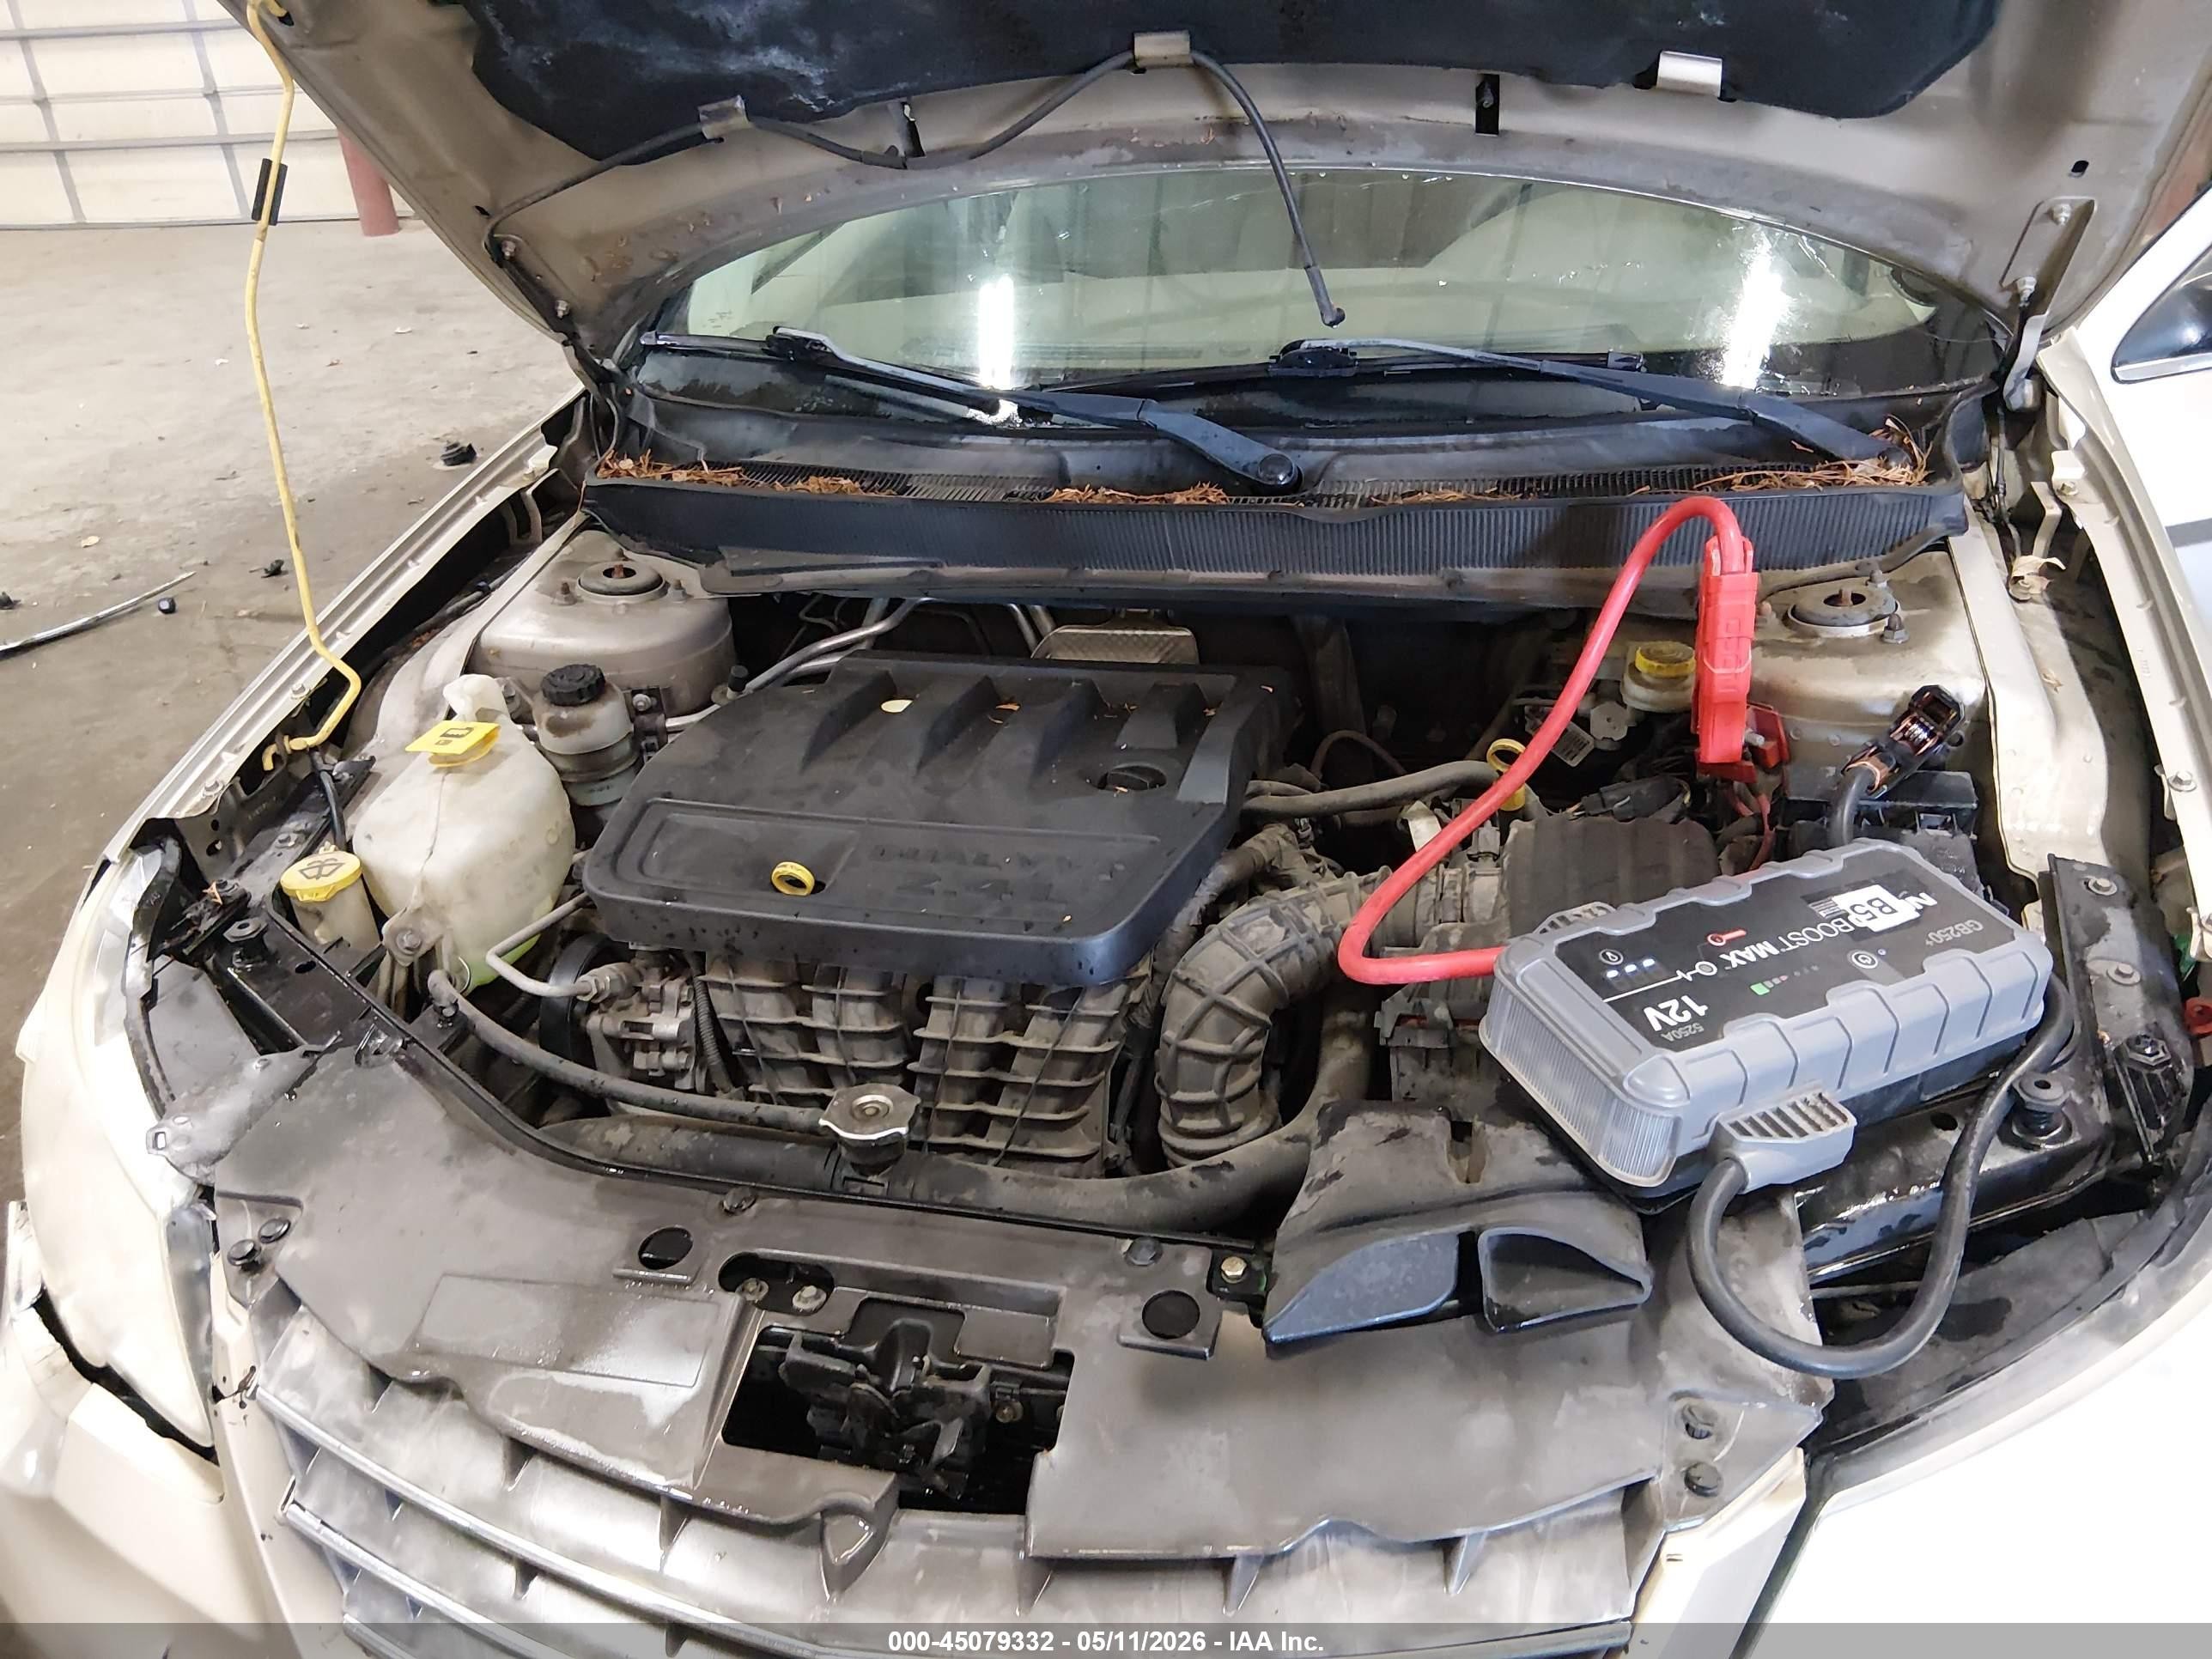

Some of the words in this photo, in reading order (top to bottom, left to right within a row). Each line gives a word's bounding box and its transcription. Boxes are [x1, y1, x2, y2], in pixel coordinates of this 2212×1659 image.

[1850, 897, 1898, 921] B5
[1778, 918, 1854, 951] BOOST
[1925, 919, 1984, 946] GB250+
[1720, 941, 1779, 968] MAX
[1644, 995, 1709, 1031] 12V
[1661, 1022, 1705, 1042] 5250A
